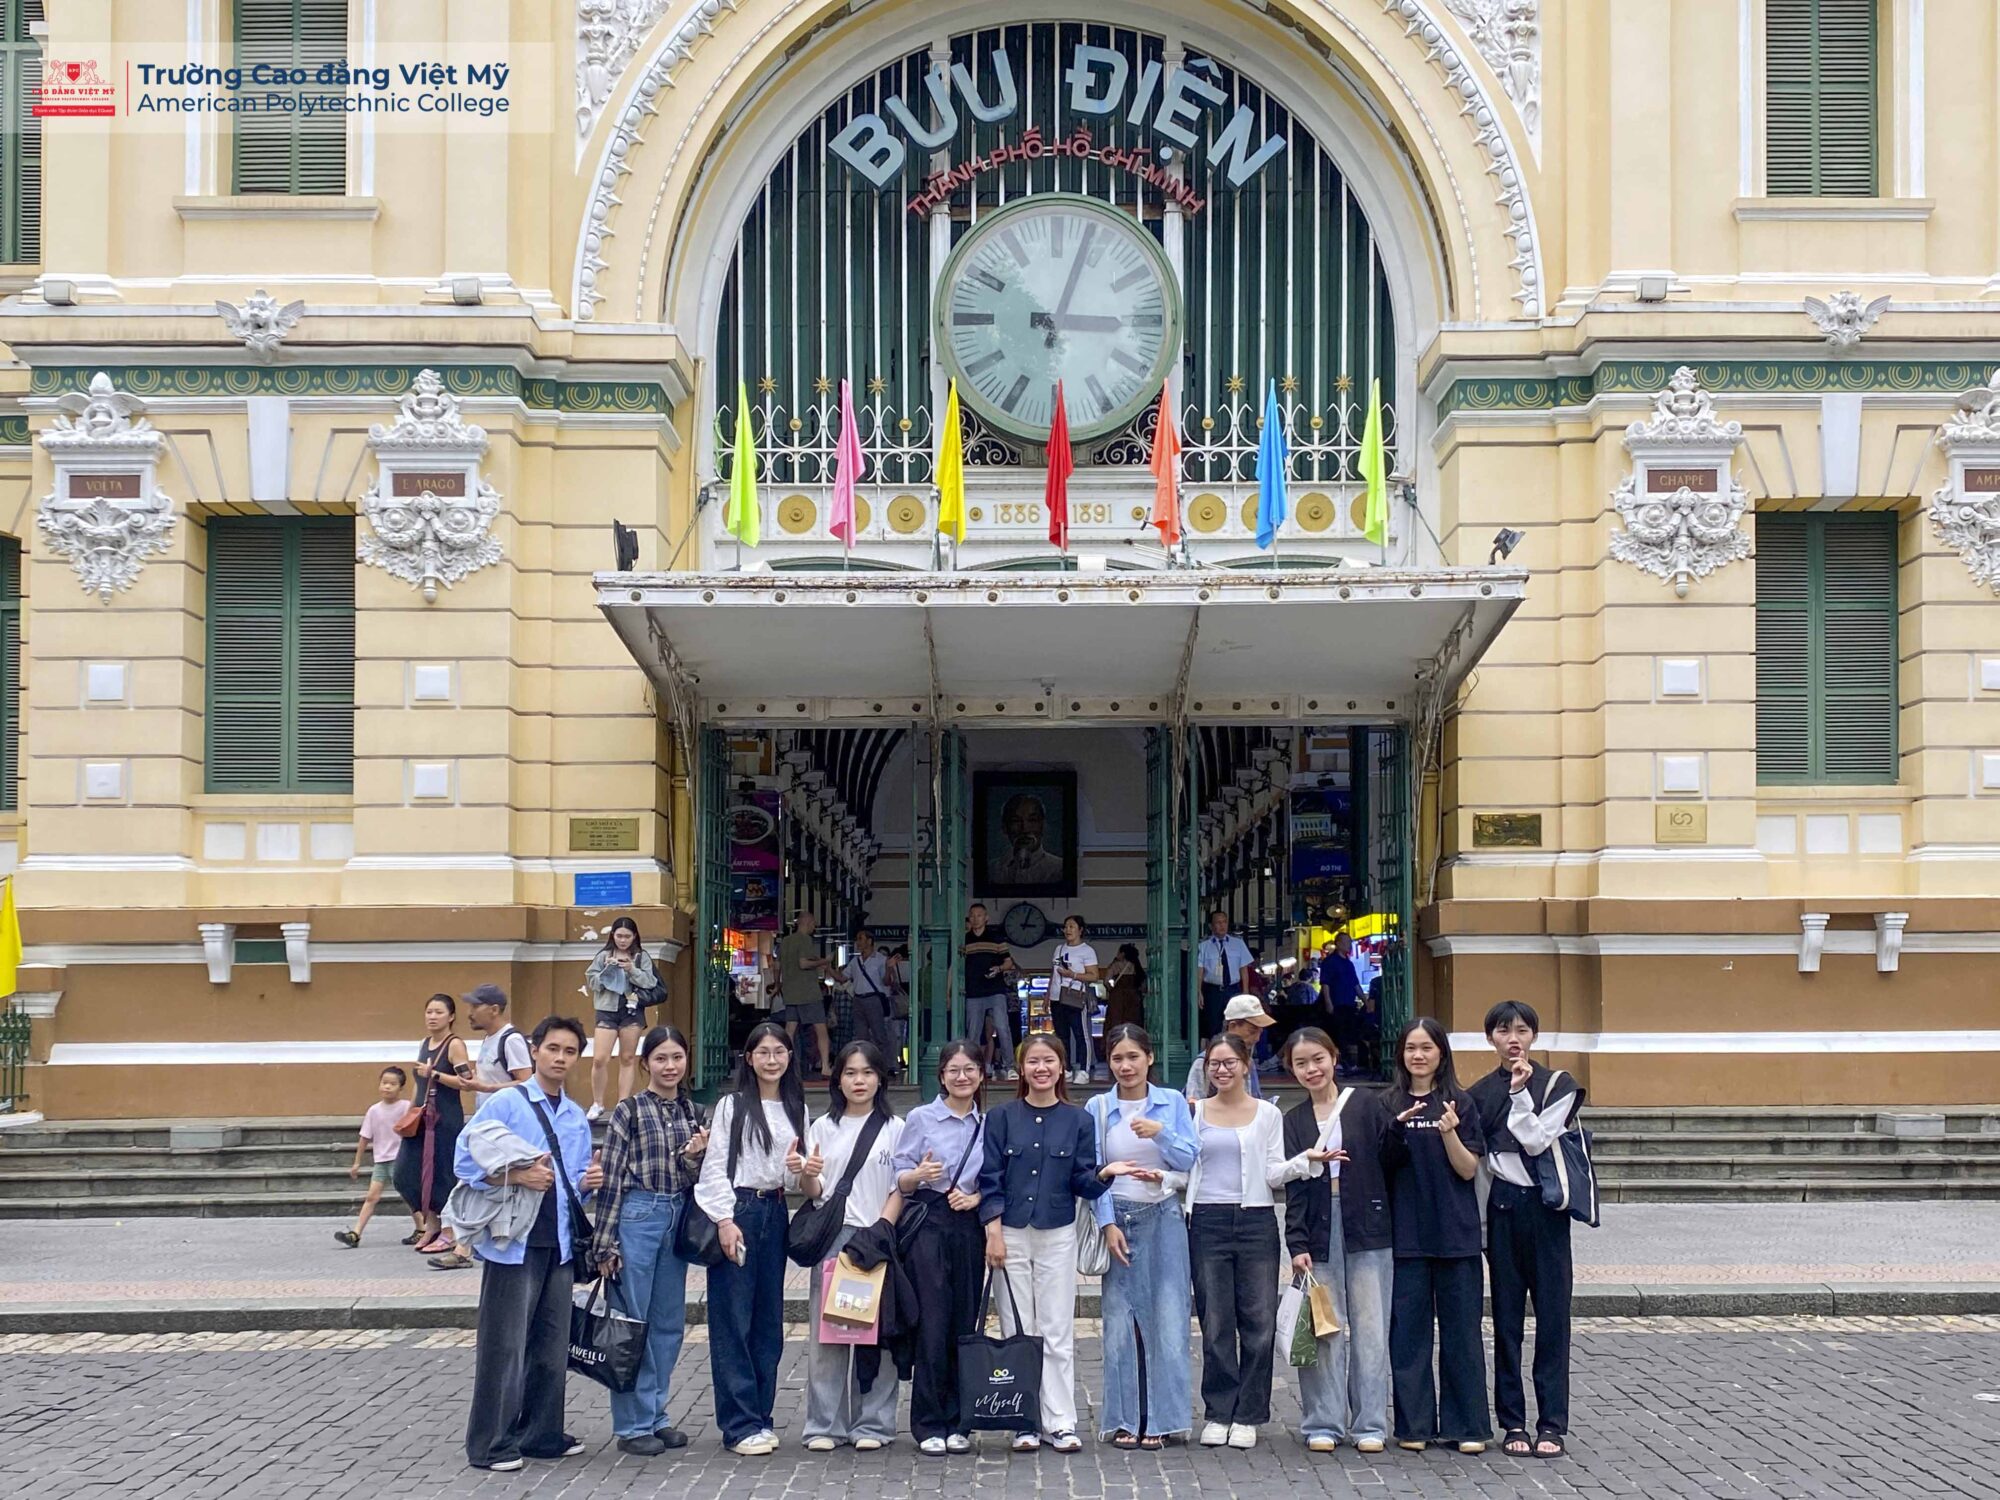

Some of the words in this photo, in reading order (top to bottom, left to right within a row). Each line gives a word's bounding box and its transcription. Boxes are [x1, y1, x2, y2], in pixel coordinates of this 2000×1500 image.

[827, 47, 1018, 190] BƯU
[1064, 43, 1288, 189] ĐIỆN
[1144, 162, 1206, 215] MINH
[86, 480, 123, 491] VOLTA
[415, 478, 456, 491] ARAGO
[1659, 474, 1705, 486] CHAPPE
[992, 503, 1041, 524] 1886
[1072, 503, 1113, 524] 1891
[975, 1391, 1023, 1415] Myself
